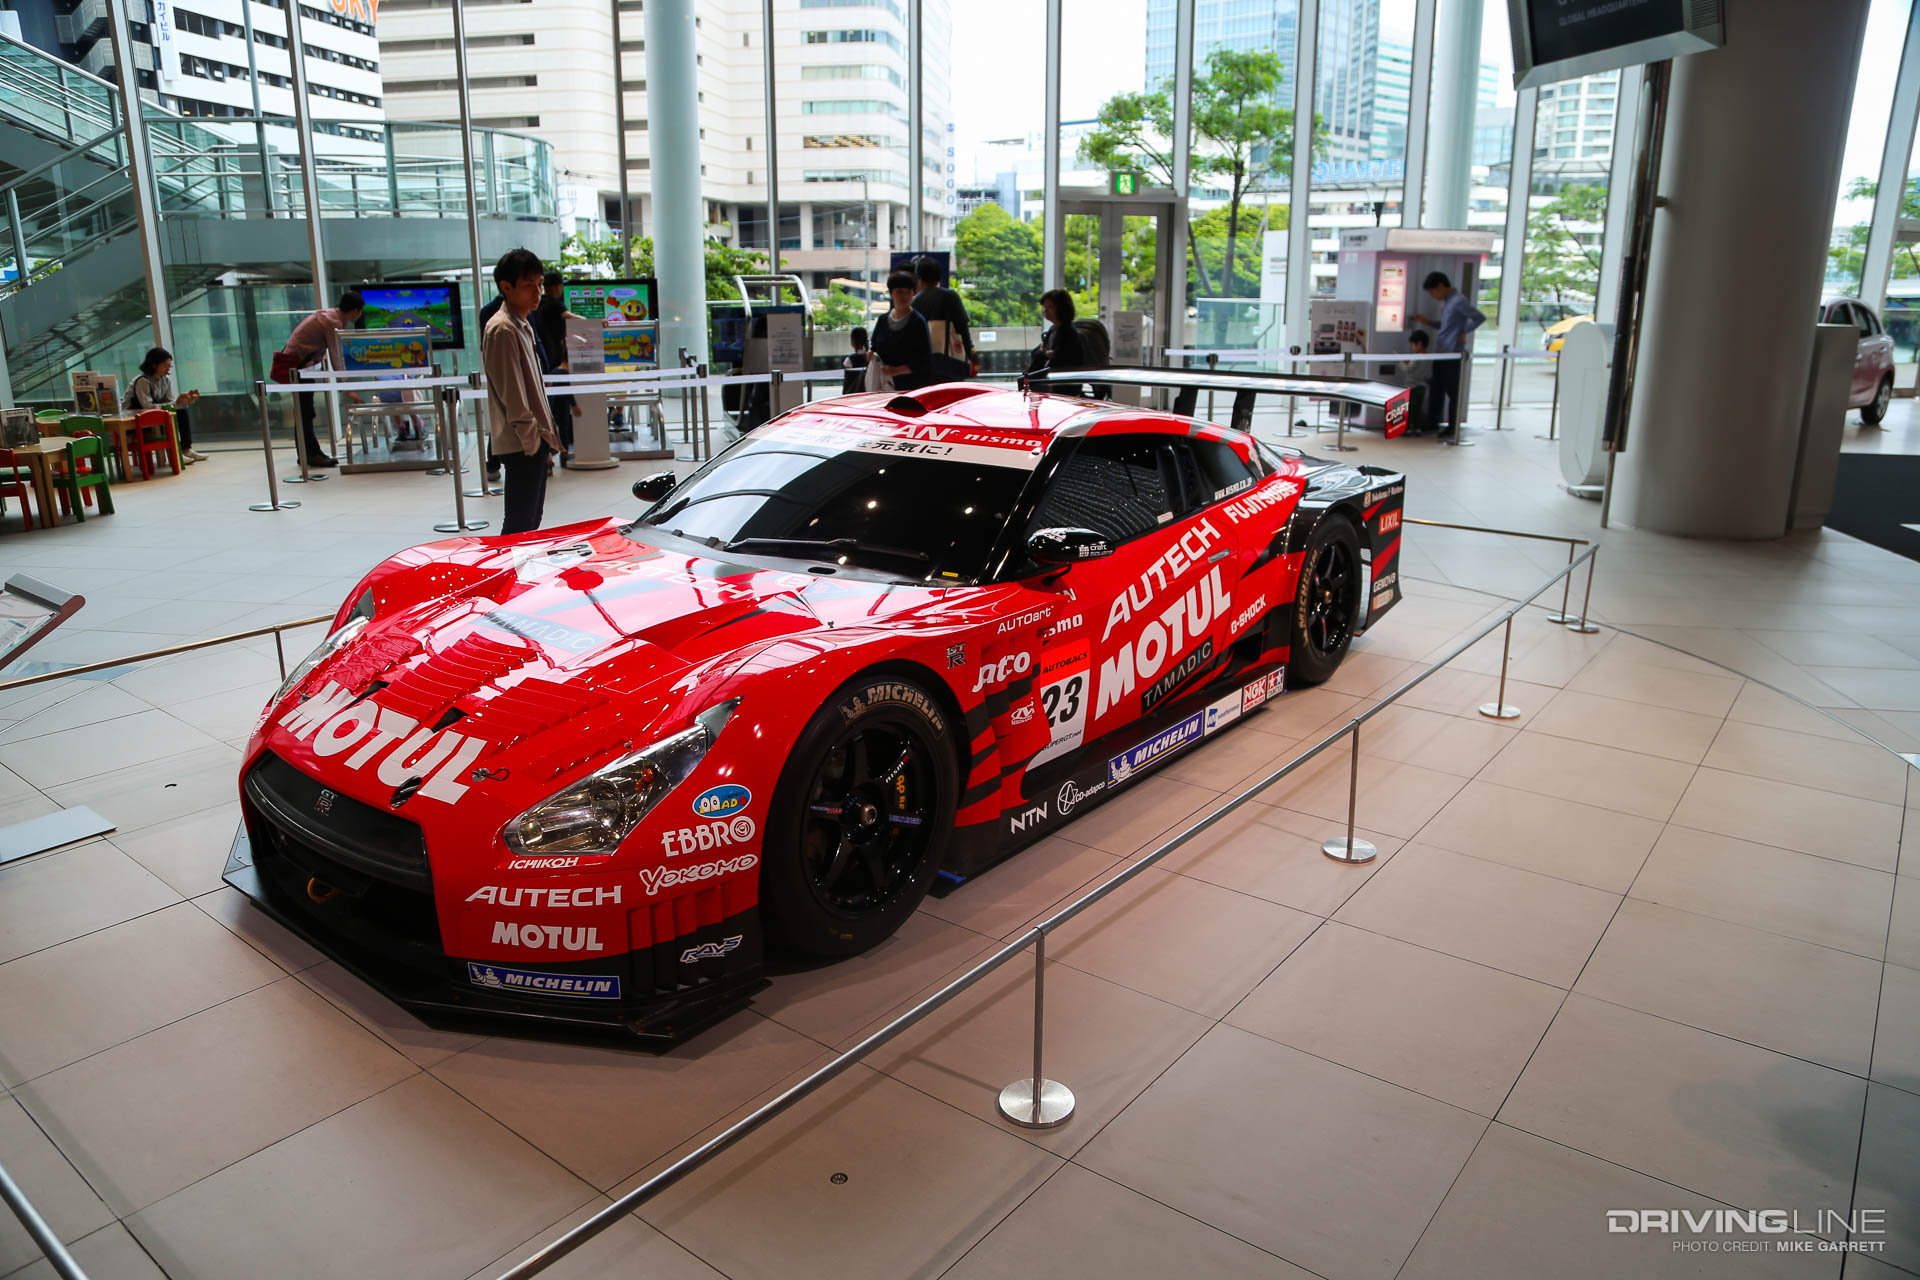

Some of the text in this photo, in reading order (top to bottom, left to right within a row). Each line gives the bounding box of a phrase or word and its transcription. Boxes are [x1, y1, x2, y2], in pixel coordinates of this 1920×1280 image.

[946, 146, 955, 205] SOGO
[1312, 159, 1406, 181] QUARTE
[1386, 402, 1409, 422] CRAFT
[822, 418, 1042, 447] NISSAN nismo
[1380, 511, 1399, 530] LIXIL
[1101, 517, 1221, 643] AUTECH
[997, 607, 1051, 635] AUTOart
[1231, 594, 1266, 634] G-SHOCK
[1095, 564, 1231, 721] MOTUL
[1042, 652, 1088, 675] AUTOBACS
[1144, 642, 1211, 707] TAMADIC
[866, 684, 943, 731] MICHELIN
[1042, 676, 1083, 729] 23
[1243, 679, 1266, 705] NGK
[277, 679, 488, 805] MOTUL
[1134, 718, 1200, 766] MICHELIN
[1010, 801, 1048, 835] NTN
[661, 815, 756, 857] EBBRO
[508, 857, 580, 870] ICHIKOH
[465, 885, 622, 908] AUTECH
[491, 921, 603, 951] MOTUL
[504, 973, 612, 992] MICHELIN
